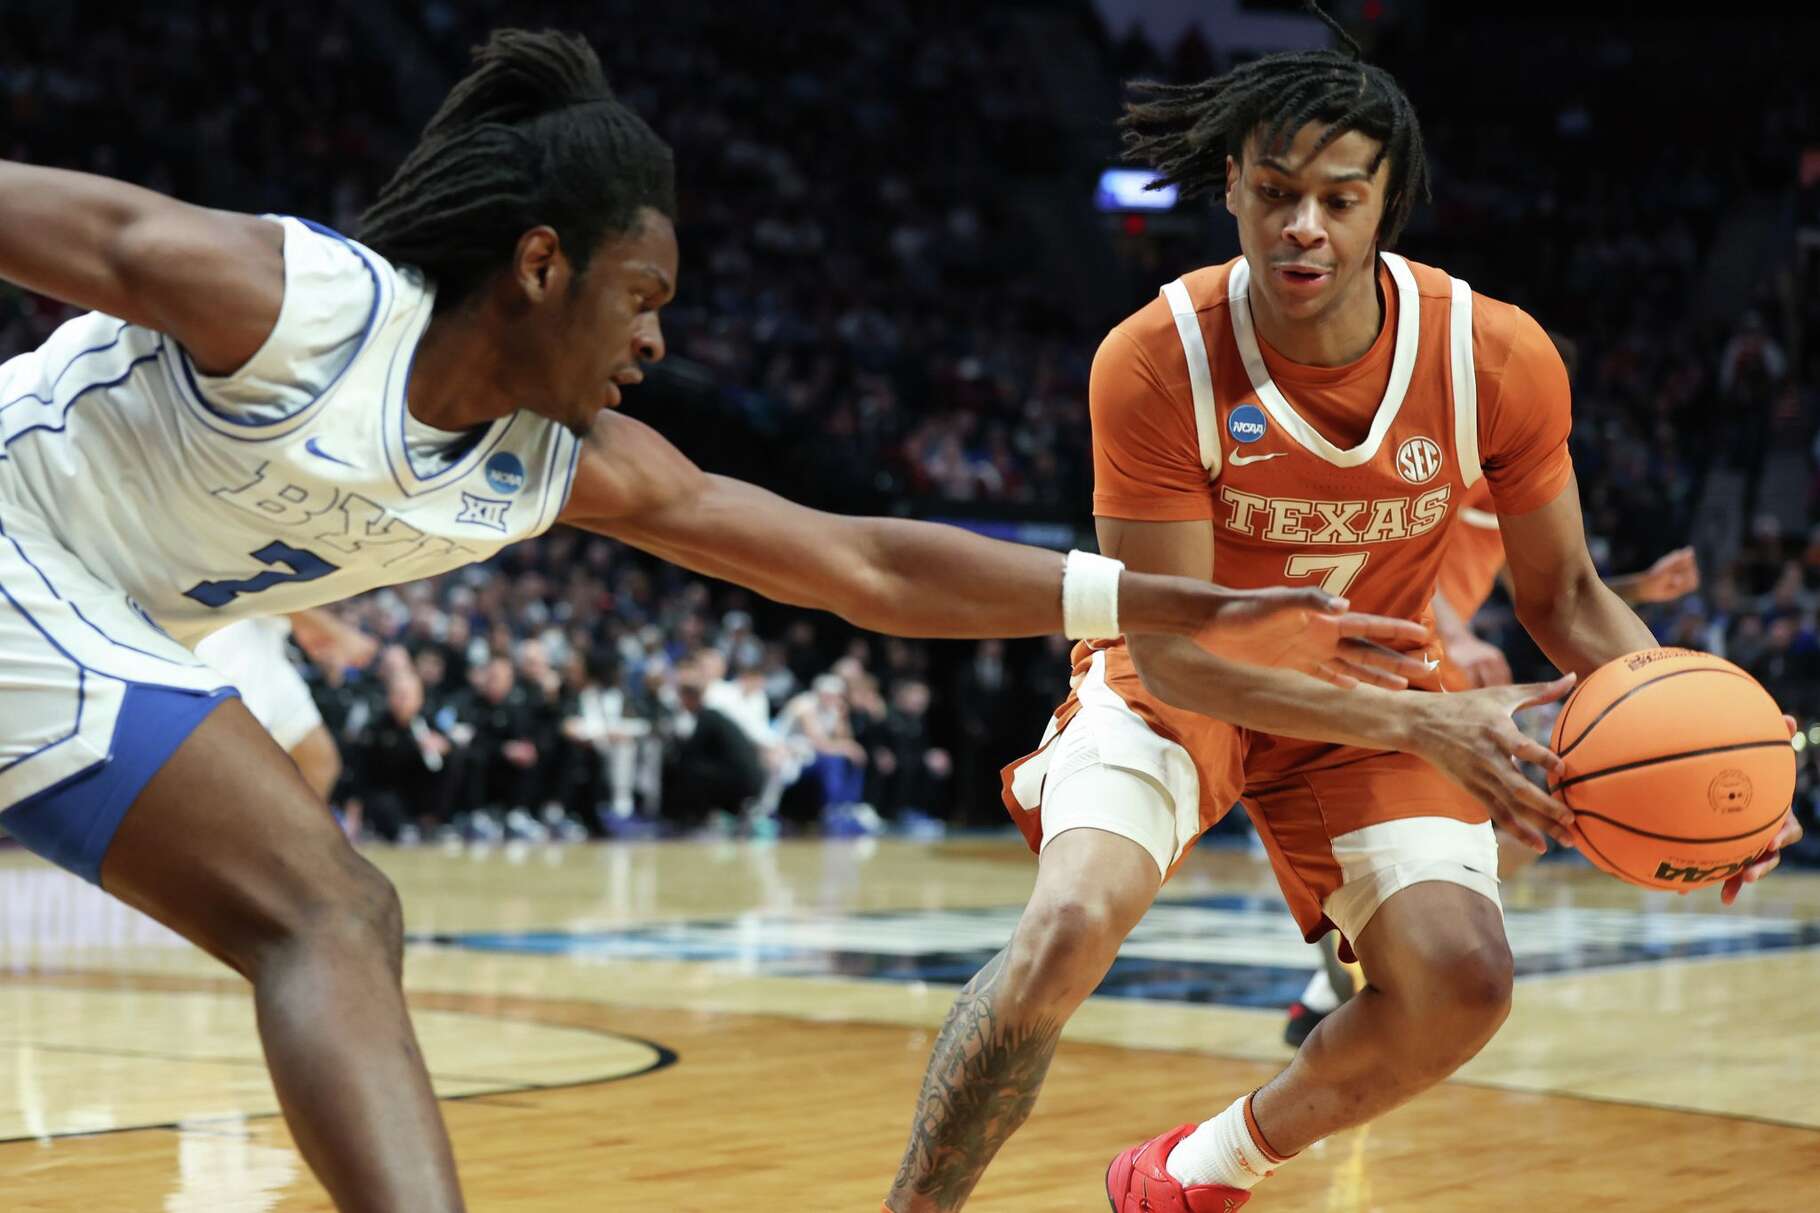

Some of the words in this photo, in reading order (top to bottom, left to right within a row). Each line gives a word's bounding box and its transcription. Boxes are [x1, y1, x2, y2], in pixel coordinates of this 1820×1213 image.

[1233, 420, 1264, 435] NCAA
[1399, 440, 1439, 483] SEC
[1220, 484, 1450, 545] TEXAS
[1284, 551, 1370, 602] 7
